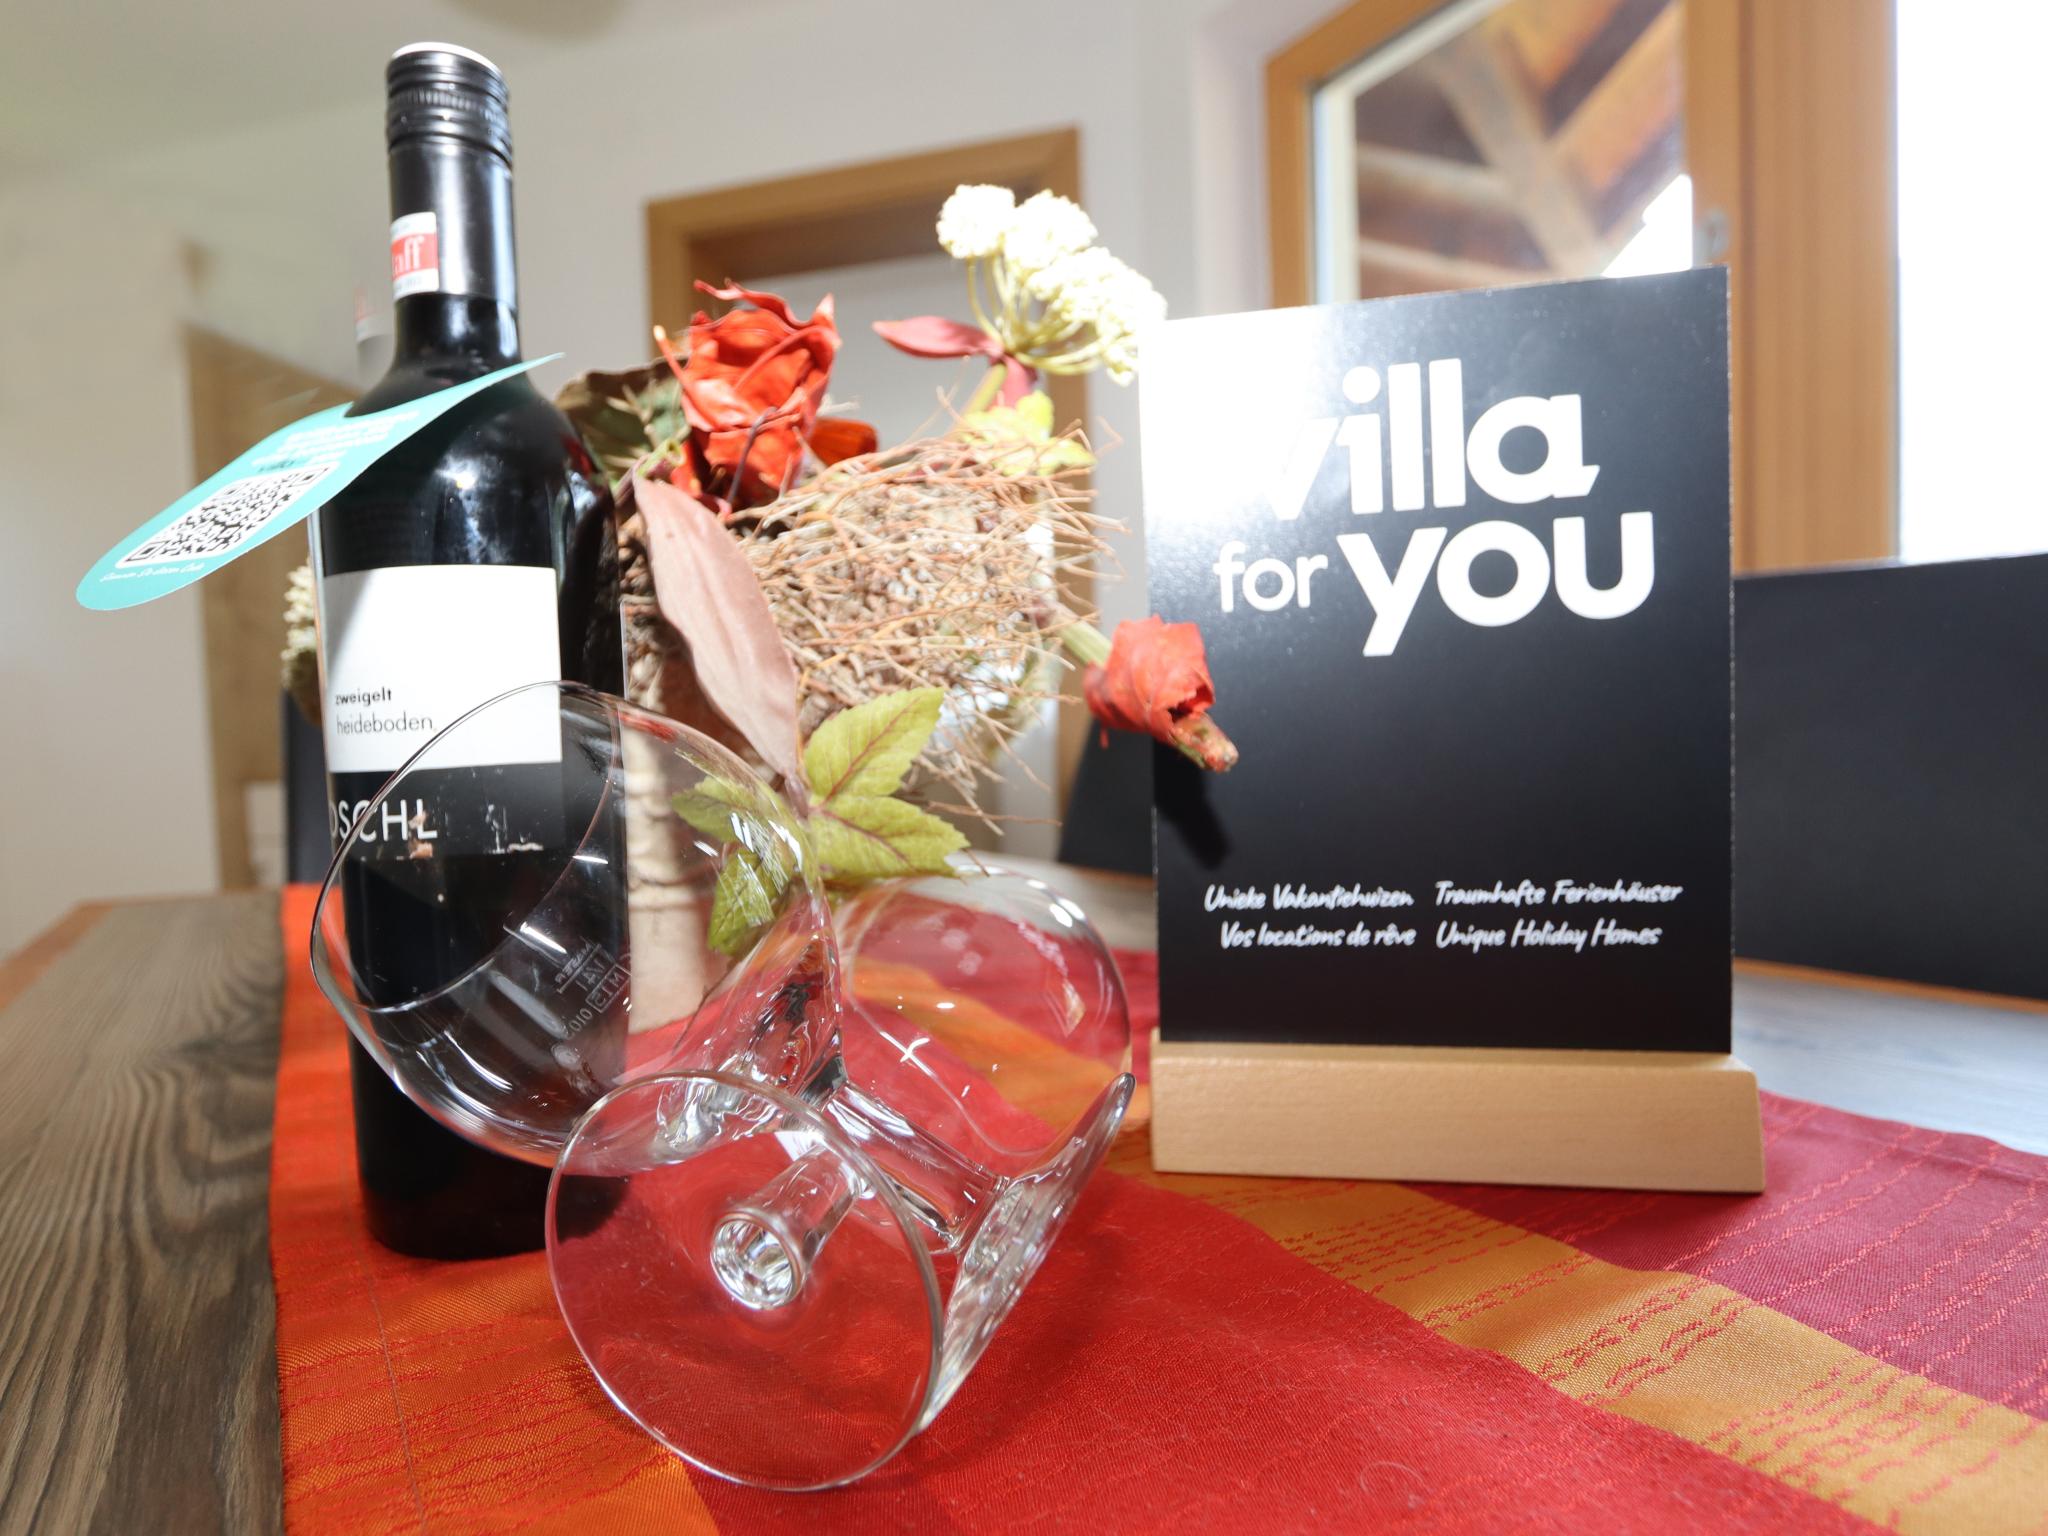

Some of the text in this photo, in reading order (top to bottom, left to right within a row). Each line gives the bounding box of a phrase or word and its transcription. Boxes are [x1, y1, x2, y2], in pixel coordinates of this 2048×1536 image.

[1252, 358, 1600, 520] villa
[1213, 511, 1655, 657] for you
[335, 686, 392, 707] zweigelt
[336, 710, 433, 735] heideboden
[1204, 883, 1266, 912] Unieke
[1435, 878, 1684, 908] Traumhafte Ferienhäuser
[1221, 920, 1417, 949] Vos locations de rêve
[1435, 917, 1663, 954] Unique Holiday Homes
